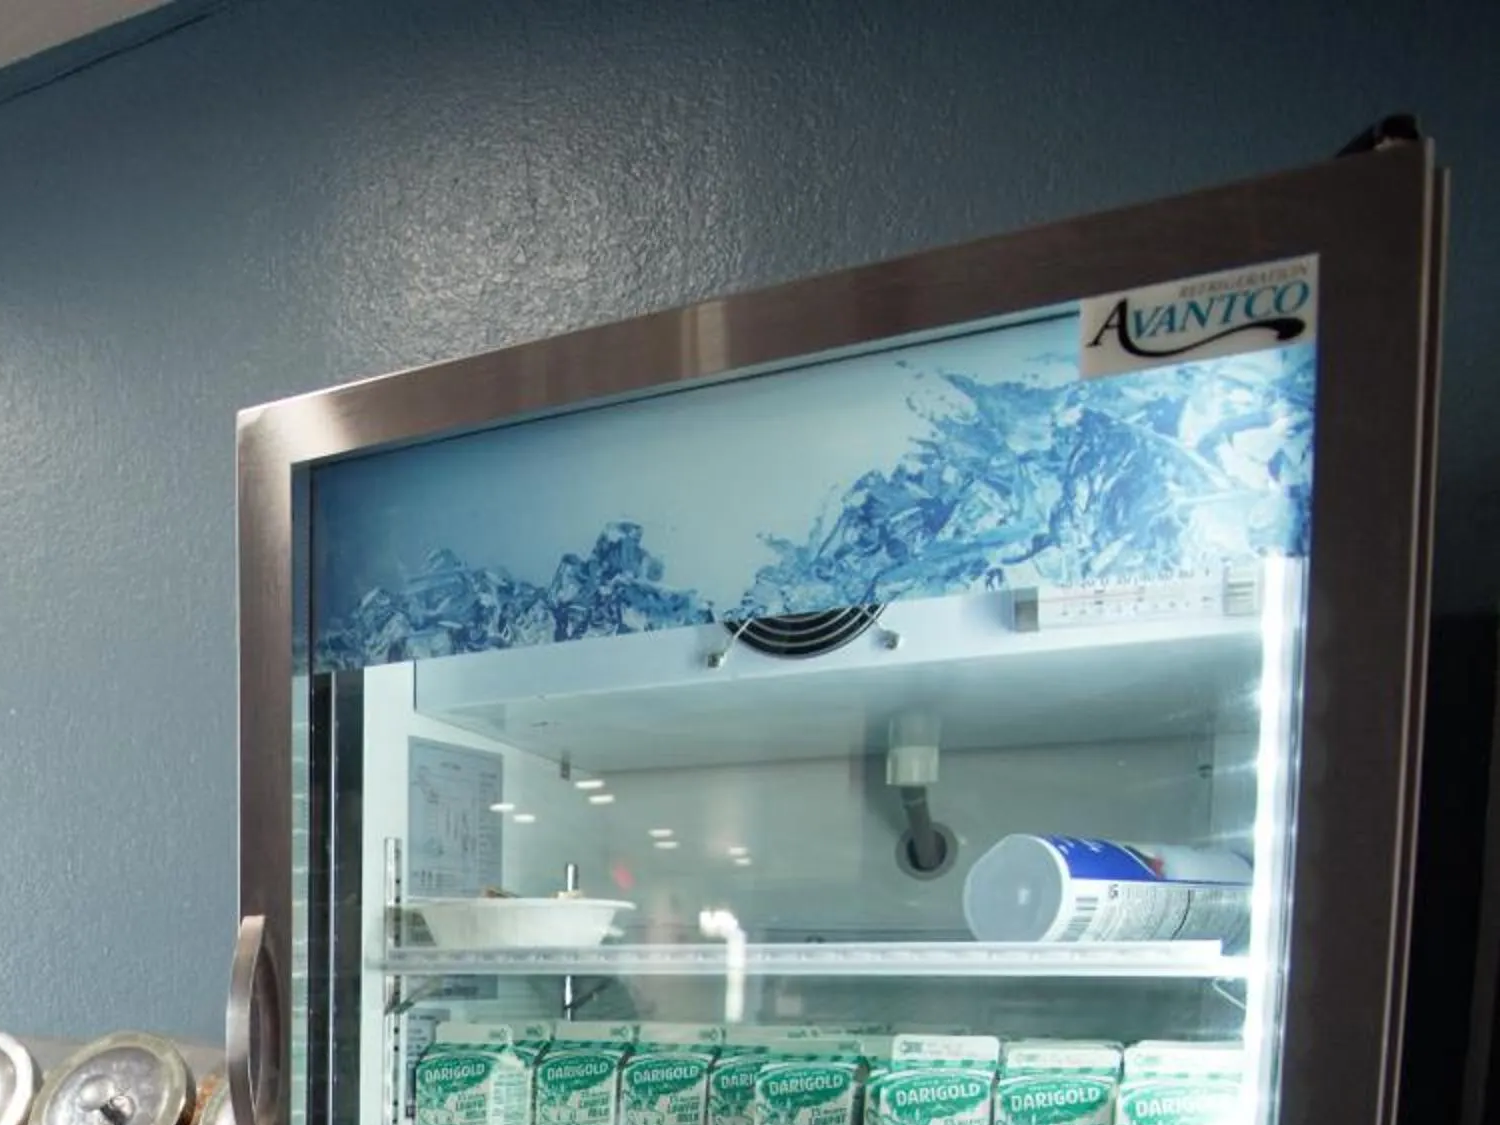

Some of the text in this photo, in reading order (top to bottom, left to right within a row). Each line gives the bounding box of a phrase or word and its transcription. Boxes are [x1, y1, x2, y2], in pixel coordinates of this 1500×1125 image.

[1085, 279, 1312, 358] AVANTCO
[424, 1063, 486, 1082] DARIGOLD
[633, 1065, 700, 1085] DARIGOLD
[720, 1072, 756, 1089] DARI
[768, 1073, 844, 1096] DARIGOLD
[895, 1083, 981, 1107] DARIGOLD
[1011, 1087, 1101, 1113] DARIGOLD
